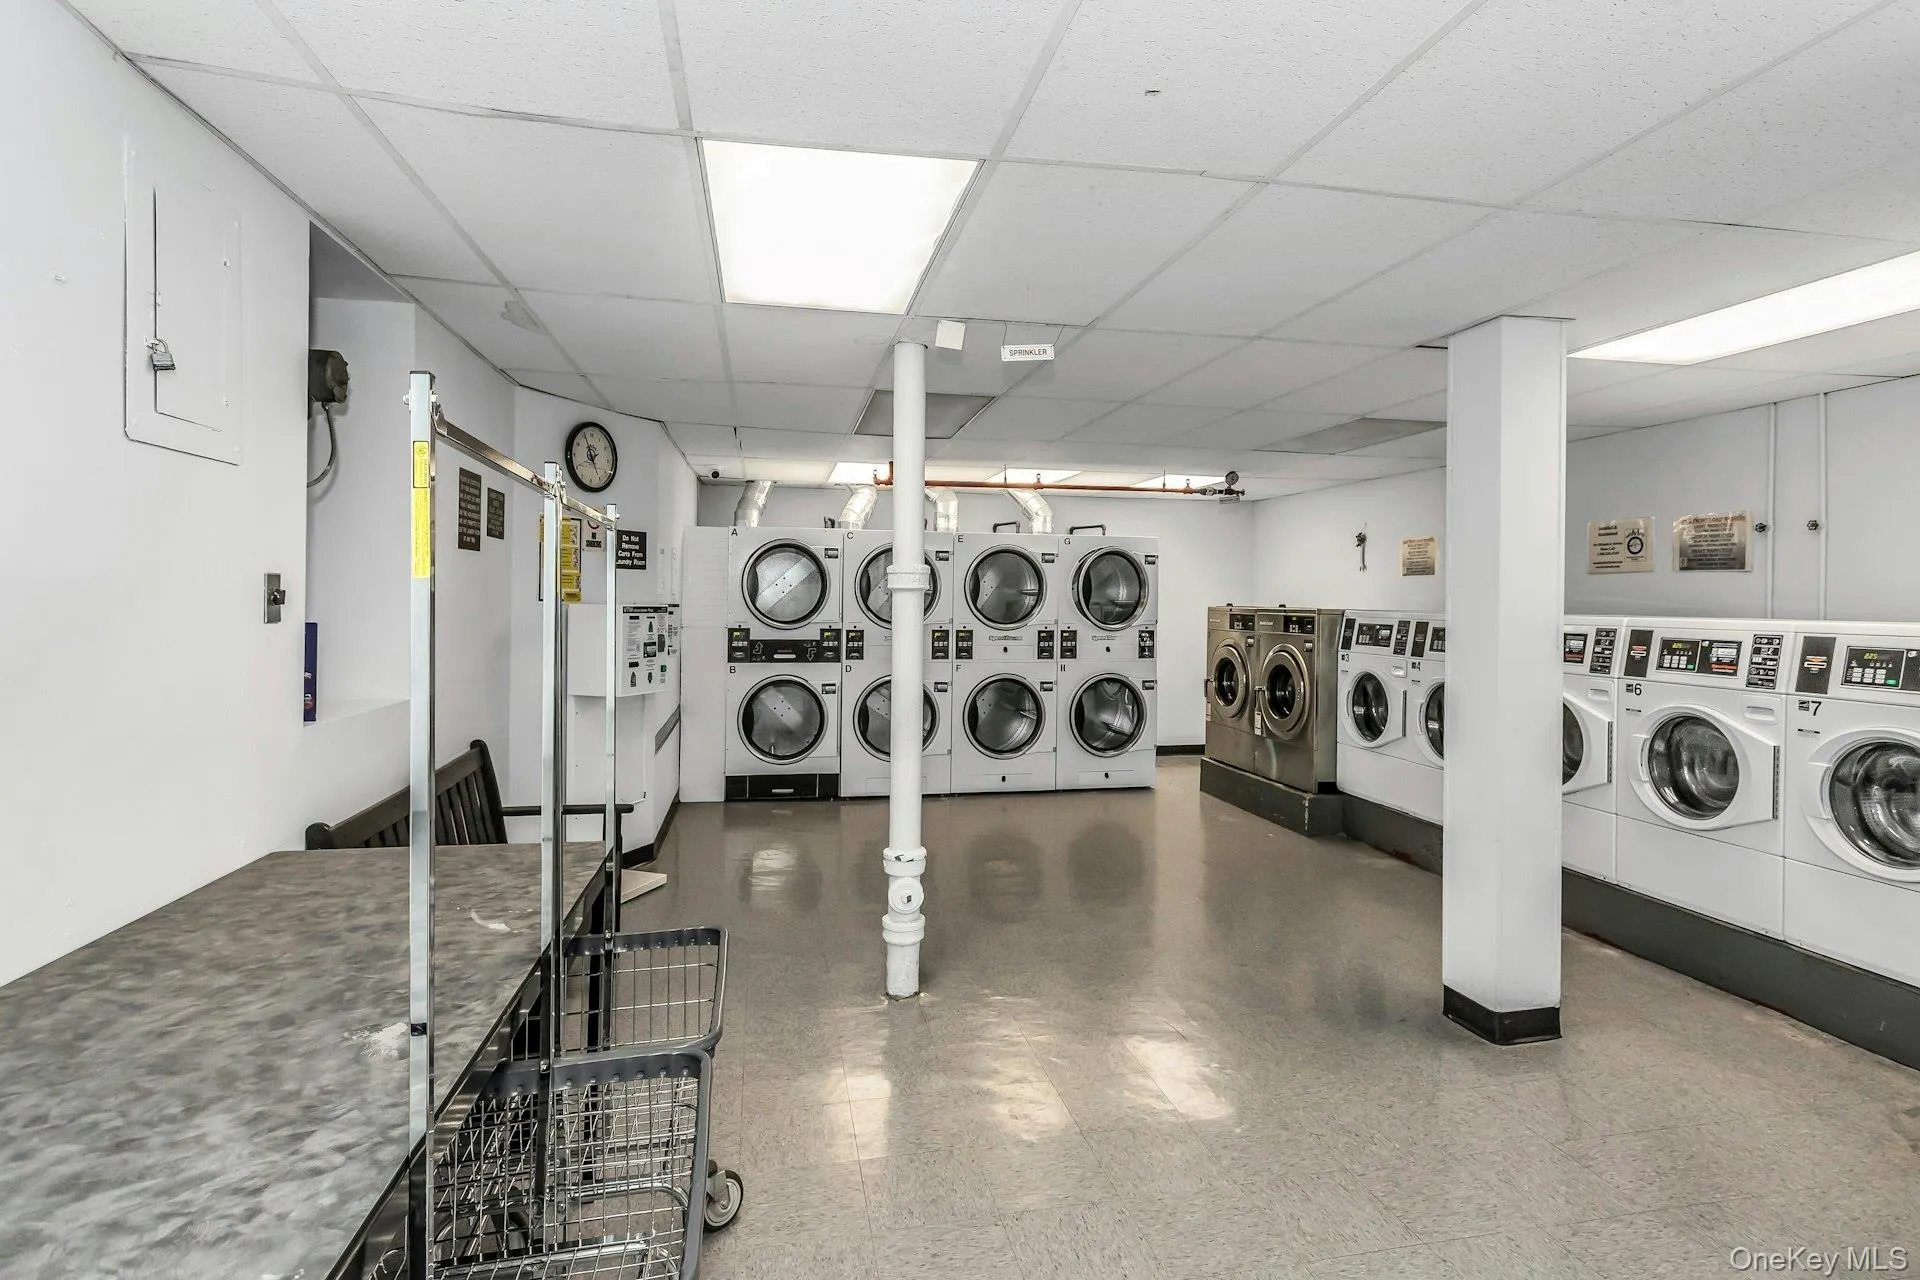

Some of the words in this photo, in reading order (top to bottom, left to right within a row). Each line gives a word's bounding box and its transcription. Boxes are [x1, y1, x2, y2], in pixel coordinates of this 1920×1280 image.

[1009, 349, 1047, 357] SPRINKLER
[731, 528, 738, 536] A
[846, 531, 854, 540] C
[957, 534, 964, 543] E
[1064, 537, 1071, 545] G
[1345, 654, 1350, 662] 3
[729, 665, 737, 674] B
[845, 664, 852, 673] D
[955, 663, 962, 672] F
[1416, 661, 1421, 671] 4
[1634, 683, 1642, 696] 6
[1811, 701, 1822, 716] 7
